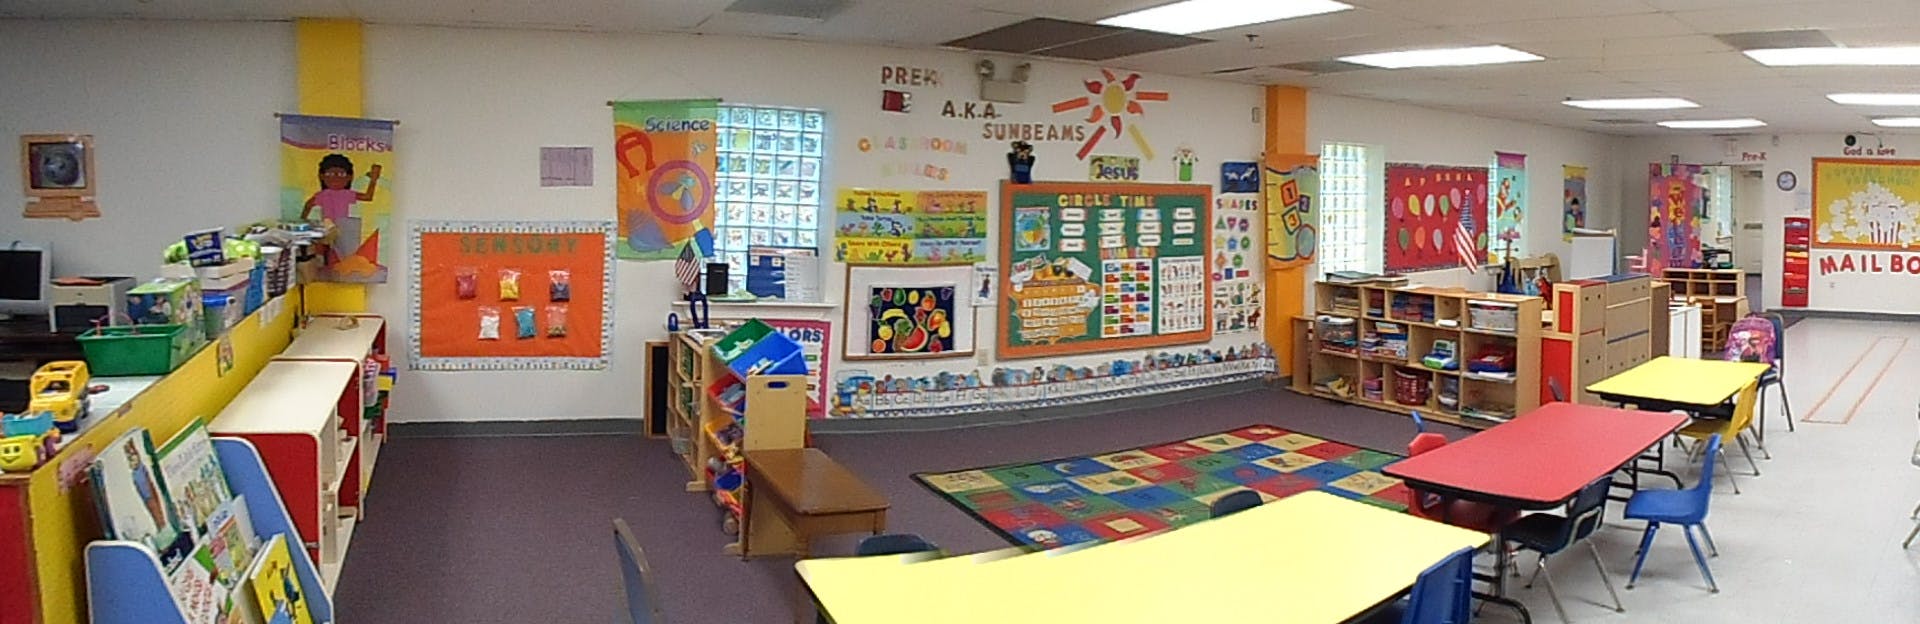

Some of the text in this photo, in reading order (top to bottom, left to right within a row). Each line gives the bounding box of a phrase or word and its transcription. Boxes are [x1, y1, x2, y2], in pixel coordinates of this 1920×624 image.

[645, 117, 709, 132] Science
[982, 122, 1085, 142] SUNBEAMS
[328, 134, 386, 152] Blocks
[1843, 146, 1862, 156] God
[1096, 163, 1139, 180] Jesus
[1057, 194, 1156, 207] CIRCLE TIME
[1286, 187, 1294, 200] 1
[1215, 198, 1258, 211] SHAPES
[1287, 213, 1297, 227] 3
[460, 236, 578, 254] SENSORY
[781, 328, 821, 343] ORS
